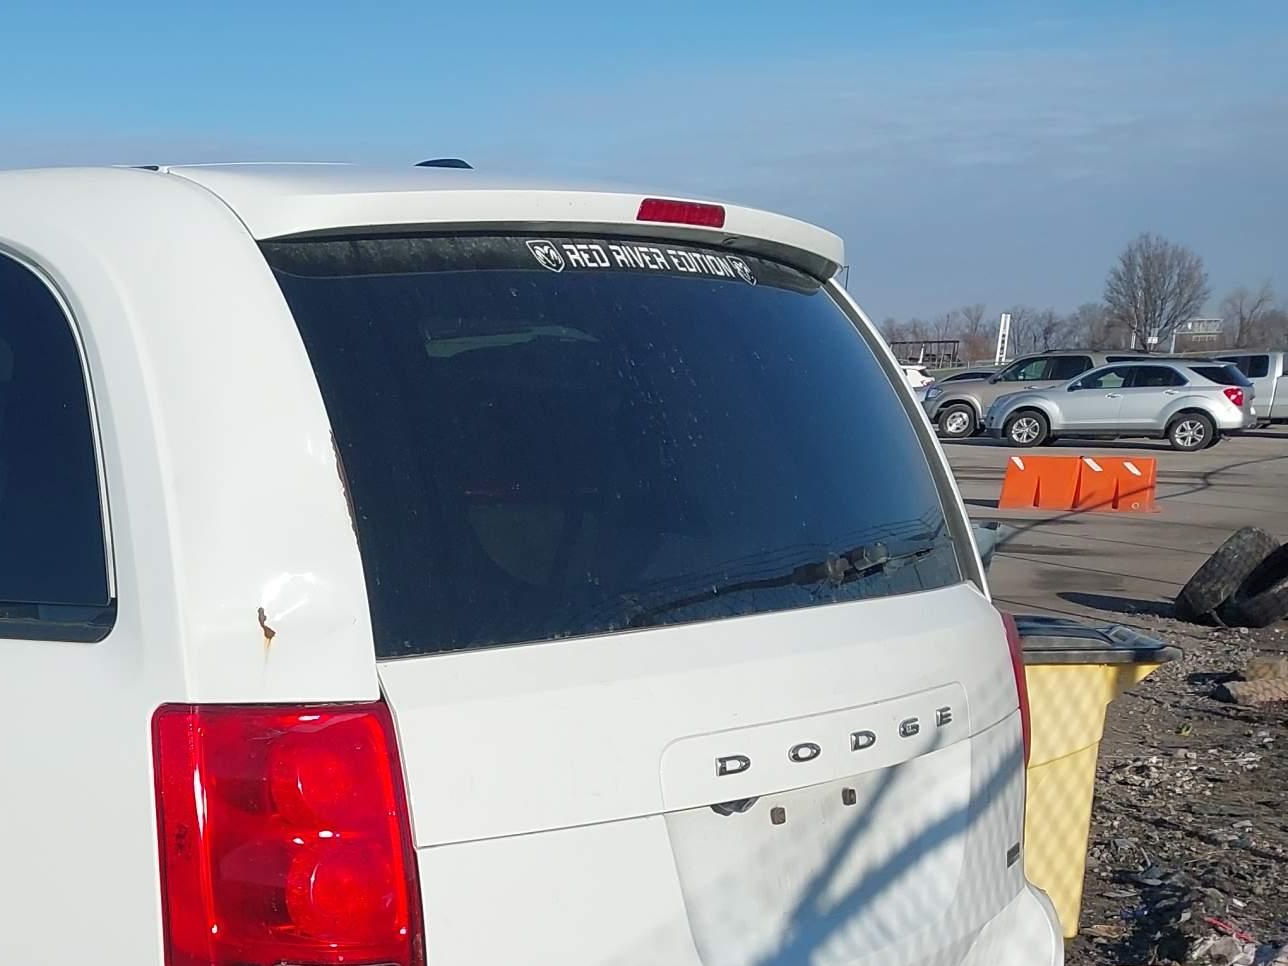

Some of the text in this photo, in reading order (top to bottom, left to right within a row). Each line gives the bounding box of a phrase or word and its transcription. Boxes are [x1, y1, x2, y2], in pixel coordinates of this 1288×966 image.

[562, 244, 737, 278] RED RIVER EDITION
[715, 706, 953, 777] DODGE
